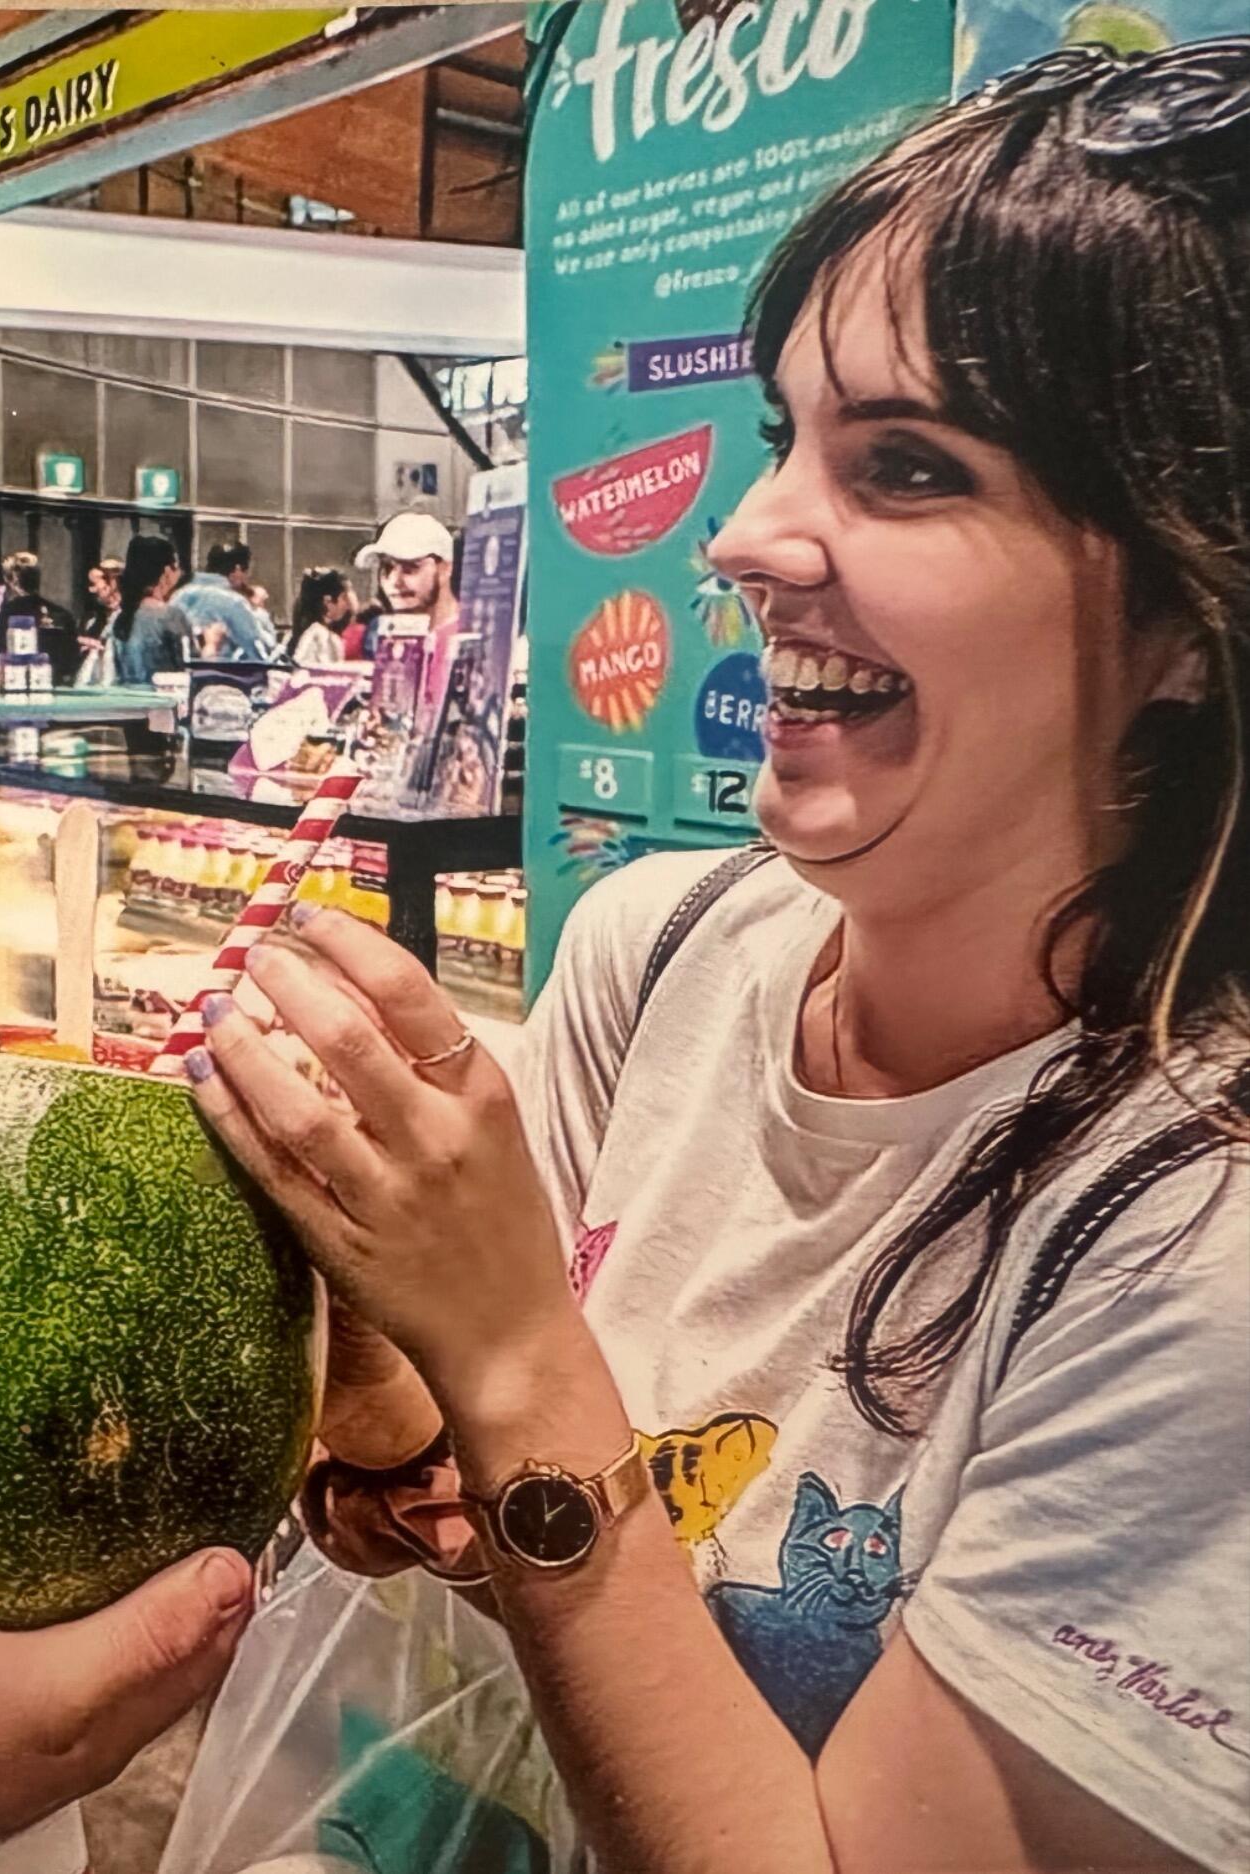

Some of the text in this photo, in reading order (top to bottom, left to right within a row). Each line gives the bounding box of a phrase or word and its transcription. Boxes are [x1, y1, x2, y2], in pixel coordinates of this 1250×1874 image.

[24, 58, 120, 144] DAIRY
[573, 0, 870, 163] fresco
[584, 190, 607, 217] of
[712, 158, 749, 184] are
[755, 138, 811, 172] 100%
[619, 237, 662, 264] only
[558, 451, 701, 523] WATERMELON
[579, 641, 662, 688] MANGO
[579, 758, 618, 799] $8
